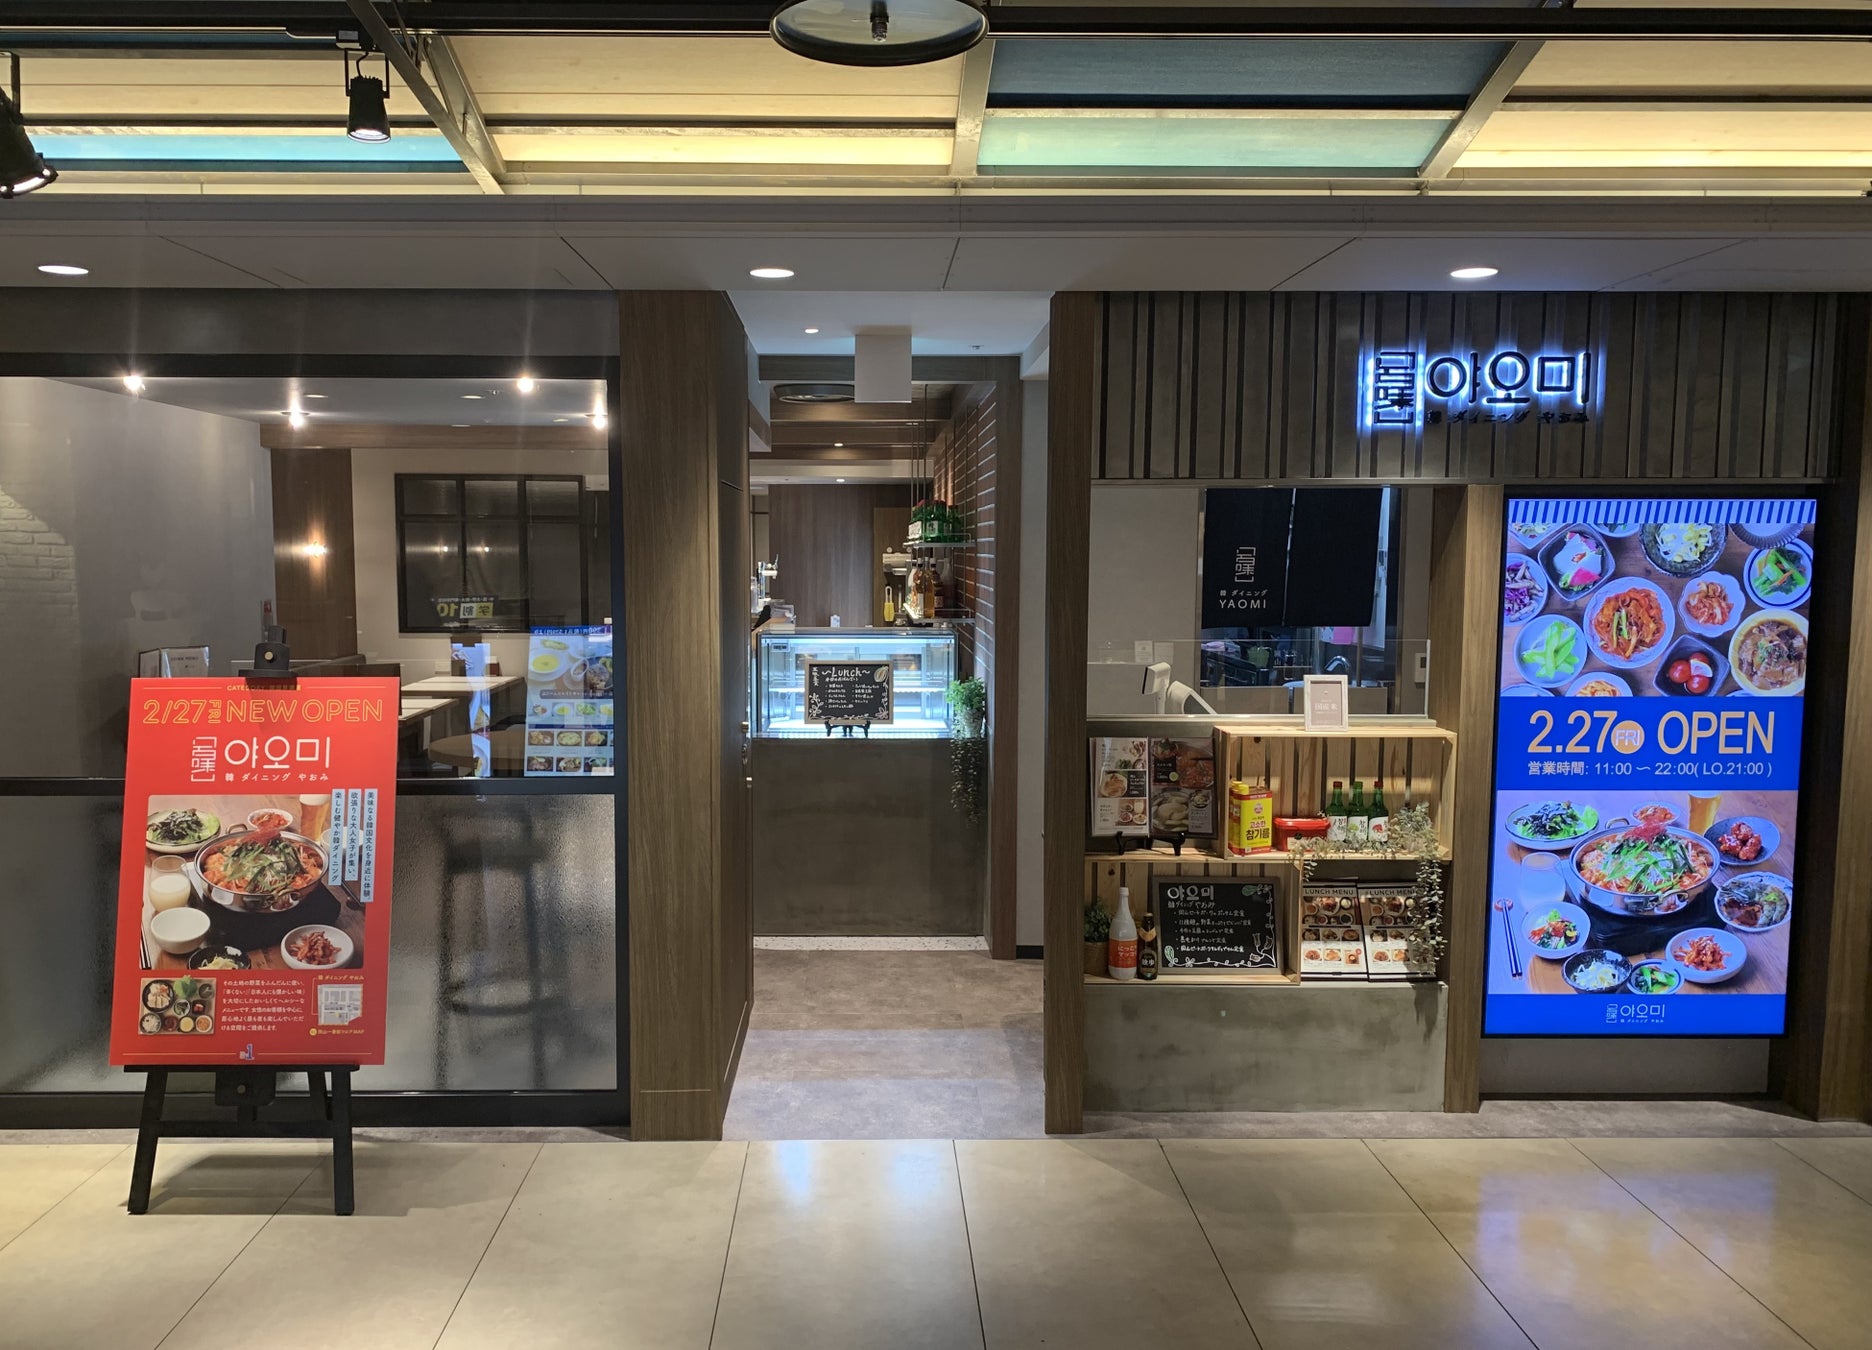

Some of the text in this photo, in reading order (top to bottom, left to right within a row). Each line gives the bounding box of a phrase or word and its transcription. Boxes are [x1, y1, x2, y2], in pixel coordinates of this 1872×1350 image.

[1427, 351, 1591, 404] 야오미
[1448, 410, 1530, 424] ダイニング
[1219, 599, 1267, 609] YAOMI
[143, 699, 383, 724] 2/27 FRI NEW OPEN
[1527, 709, 1775, 755] 2.27 FRI OPEN
[224, 735, 330, 769] 야오미
[1594, 763, 1632, 775] 11:00
[241, 772, 291, 782] ダイニング
[298, 772, 329, 782] やおみ
[1620, 1004, 1665, 1018] 야오미
